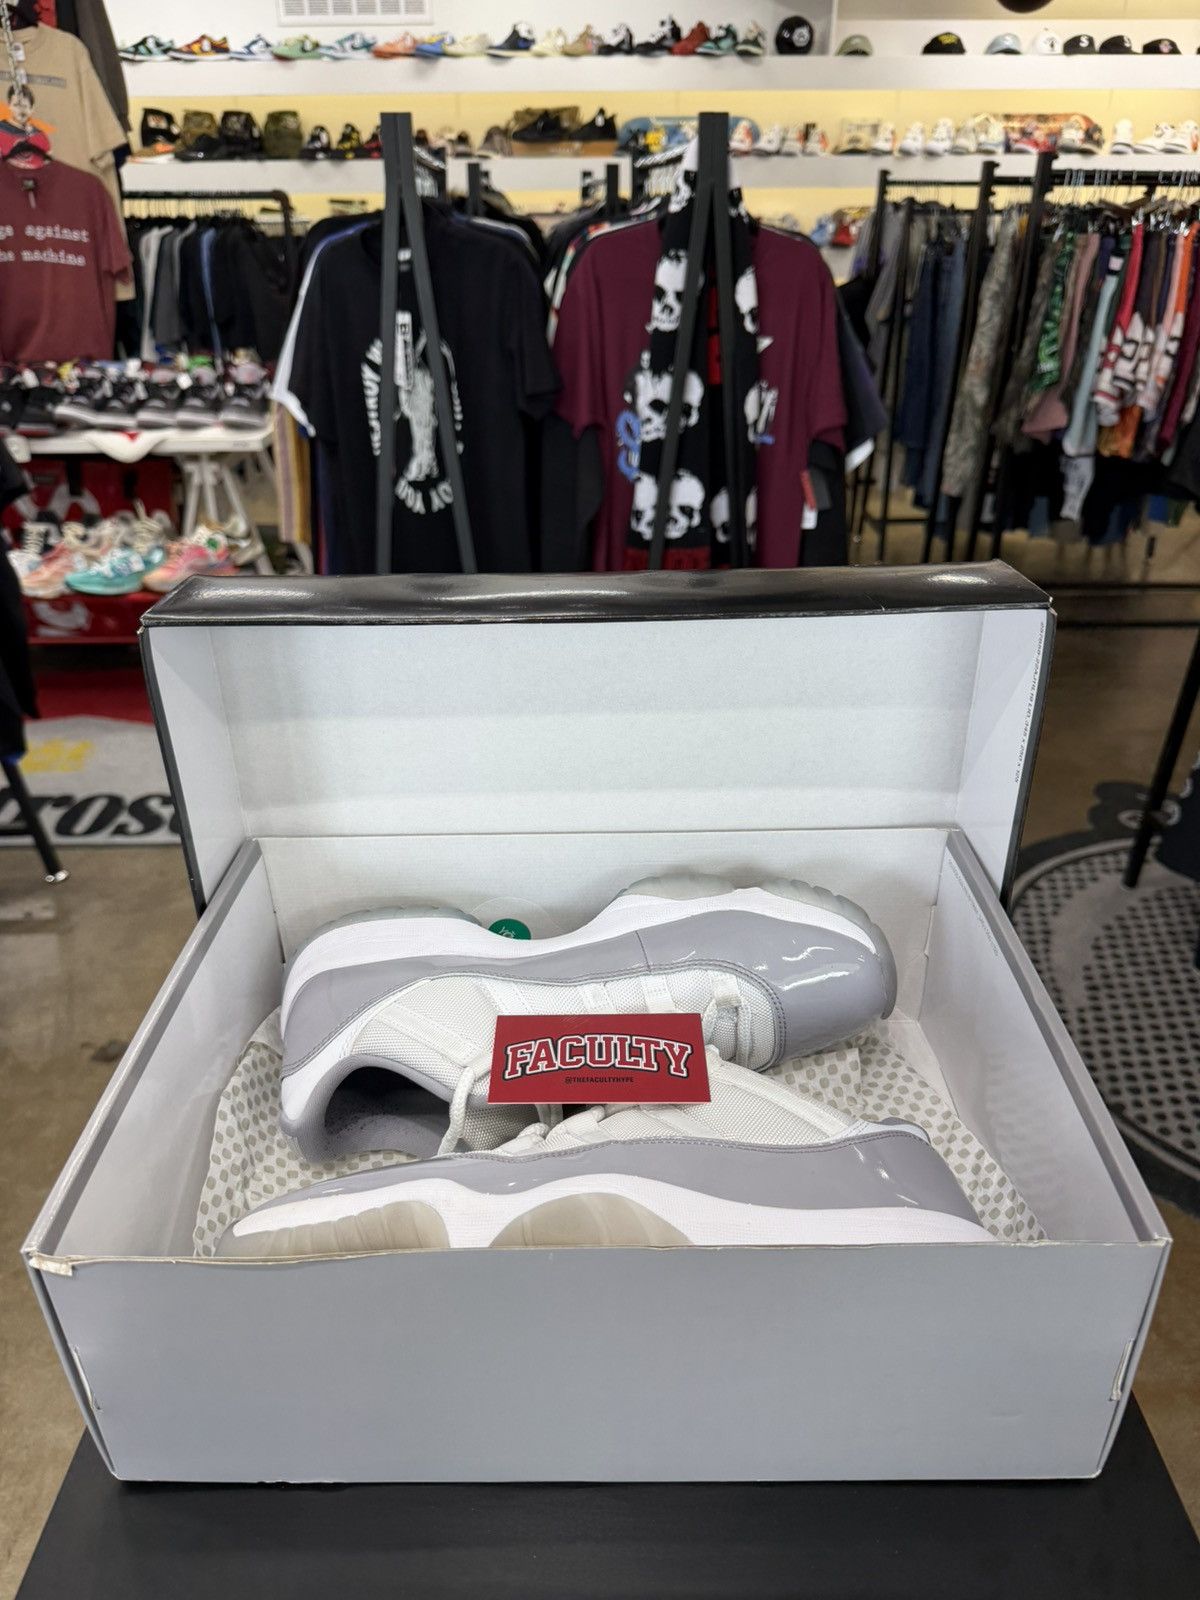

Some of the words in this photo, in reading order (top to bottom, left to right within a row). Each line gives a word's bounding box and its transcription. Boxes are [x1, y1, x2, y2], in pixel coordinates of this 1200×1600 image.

[24, 224, 91, 243] against
[20, 248, 87, 267] machine
[503, 1033, 695, 1081] FACULTY
[563, 1076, 635, 1085] @THEFACULTYHYPE
